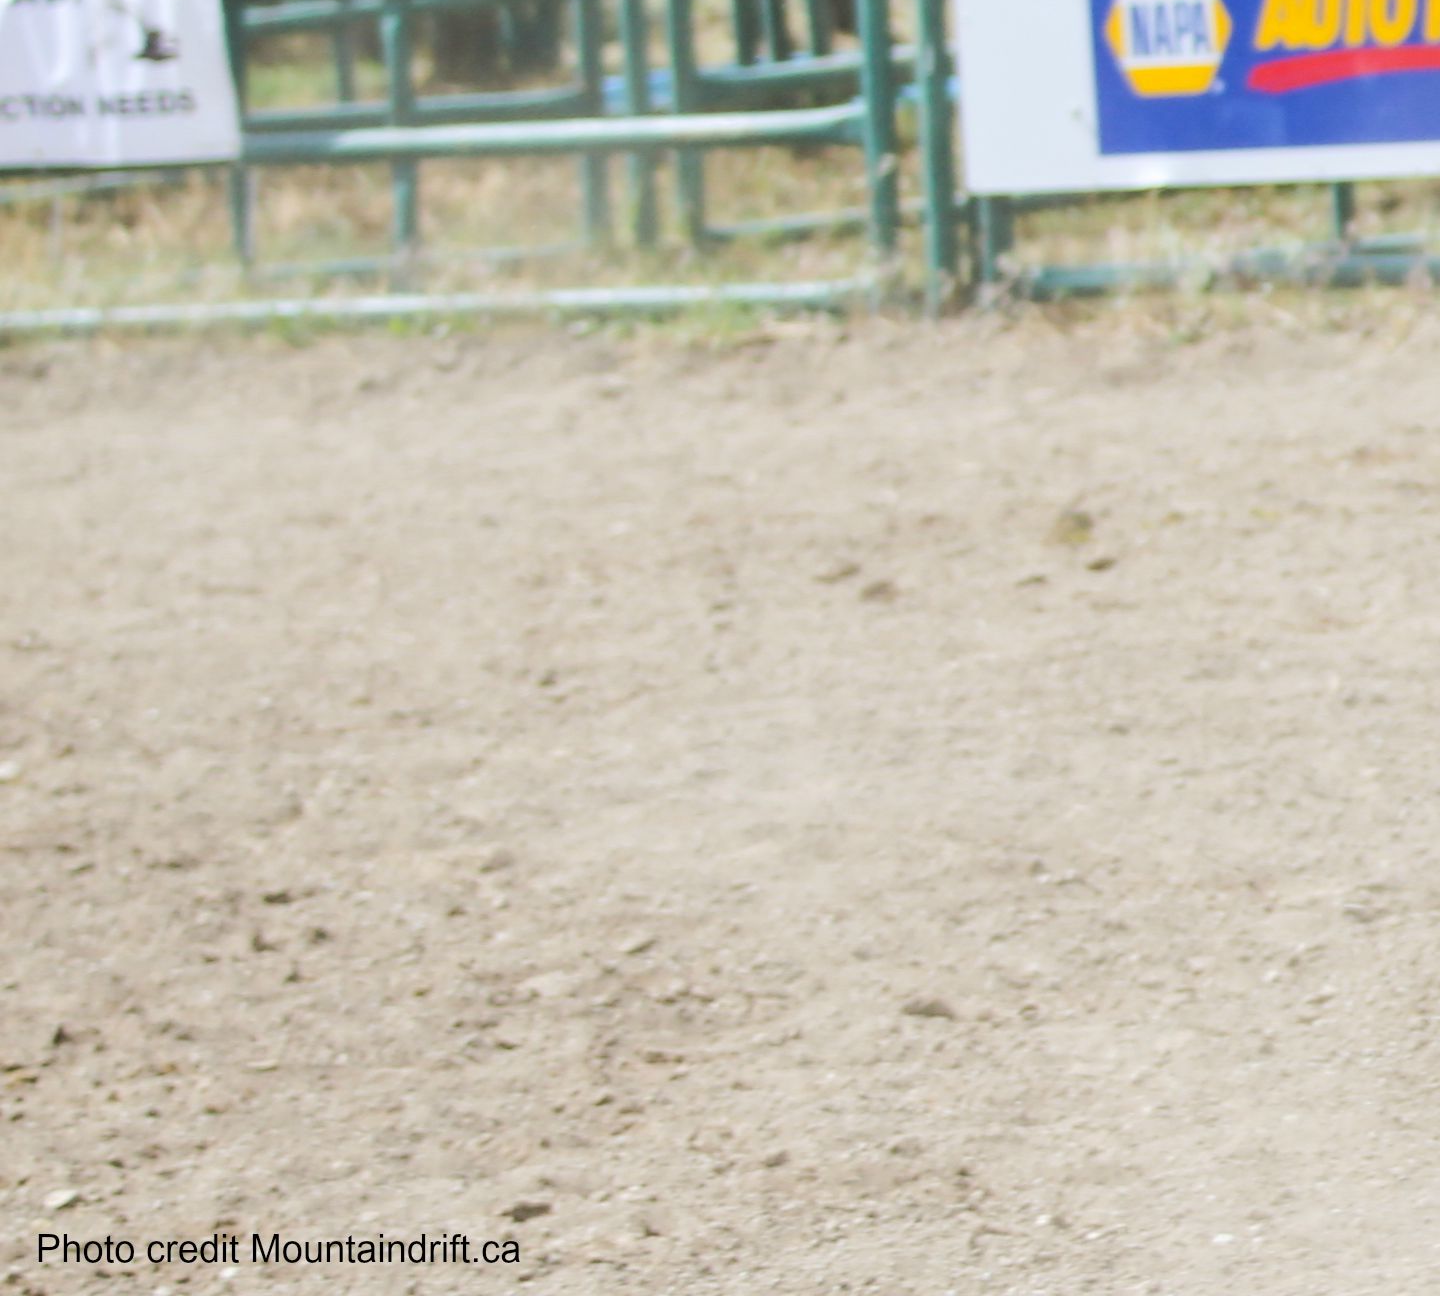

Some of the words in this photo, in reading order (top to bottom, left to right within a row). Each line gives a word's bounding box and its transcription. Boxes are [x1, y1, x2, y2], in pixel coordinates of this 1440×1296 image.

[1128, 0, 1212, 60] NAPA
[0, 92, 85, 123] CTION
[96, 87, 197, 118] NEEDS
